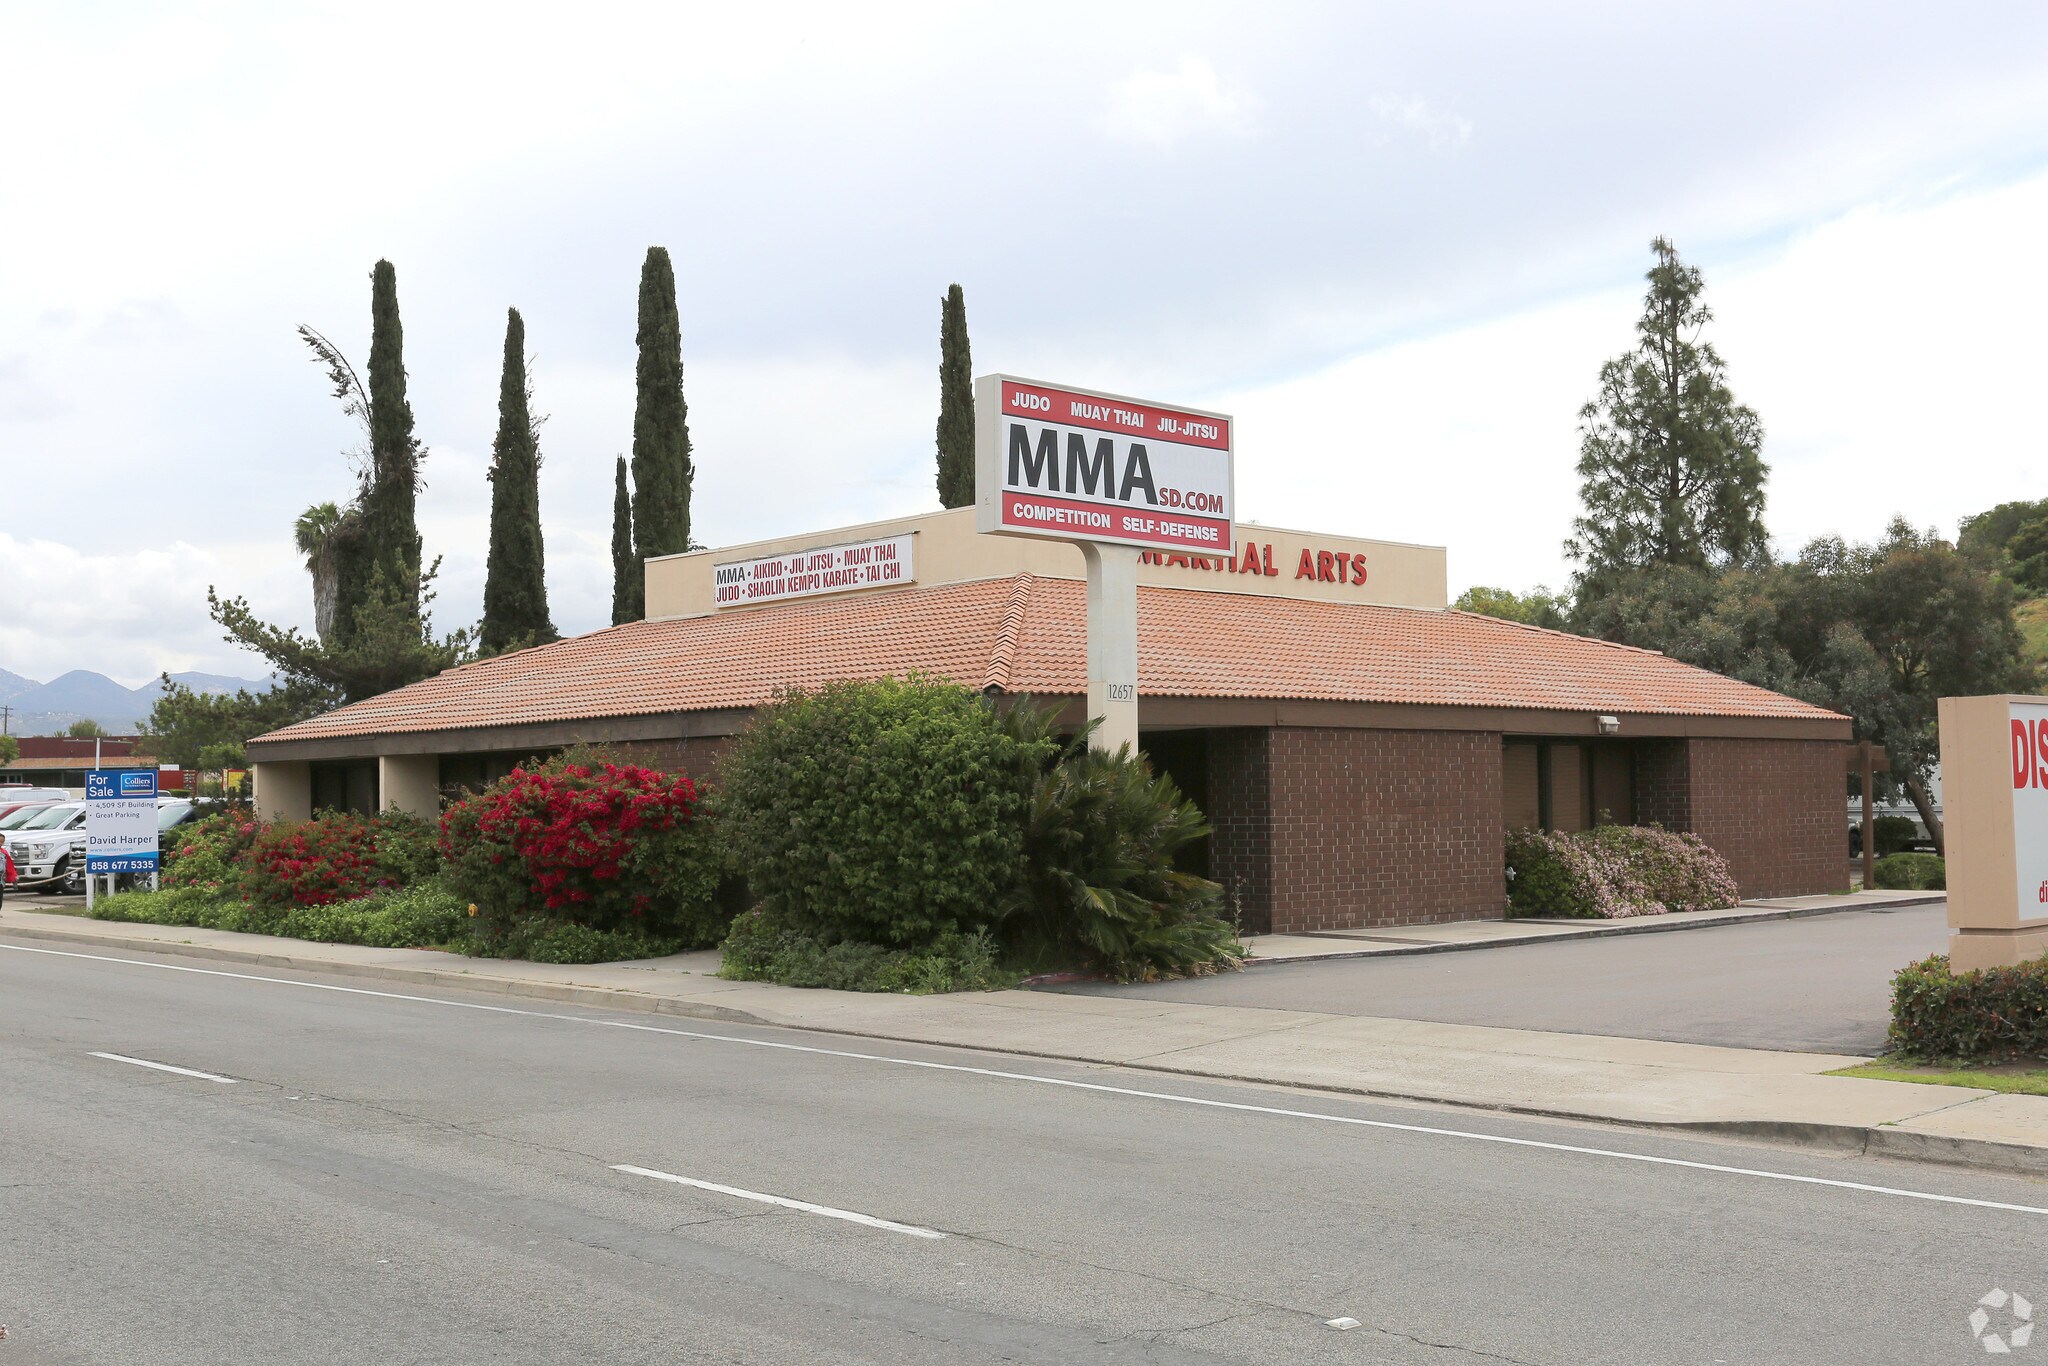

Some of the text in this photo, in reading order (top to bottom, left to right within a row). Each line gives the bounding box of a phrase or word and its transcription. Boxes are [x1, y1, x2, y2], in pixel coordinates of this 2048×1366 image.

[1011, 391, 1218, 440] JUDO MUAY THAI JIU-JITSU
[1007, 423, 1224, 514] MMA SD.COM
[1013, 502, 1219, 542] COMPETITION SELF-DEFENSE
[716, 543, 896, 585] MMA AIKIDO JIU JITSU MUAY THAI
[1295, 548, 1368, 586] ARTS
[716, 562, 901, 603] JUDO SHAOLIN KEMPO KARATE TAI CHI
[1109, 684, 1134, 700] 12657
[89, 774, 109, 785] For
[124, 777, 151, 785] Colliers
[89, 786, 114, 797] Sale
[115, 811, 140, 819] Parking
[90, 835, 153, 846] David Harper
[91, 860, 154, 870] 858 677 5335
